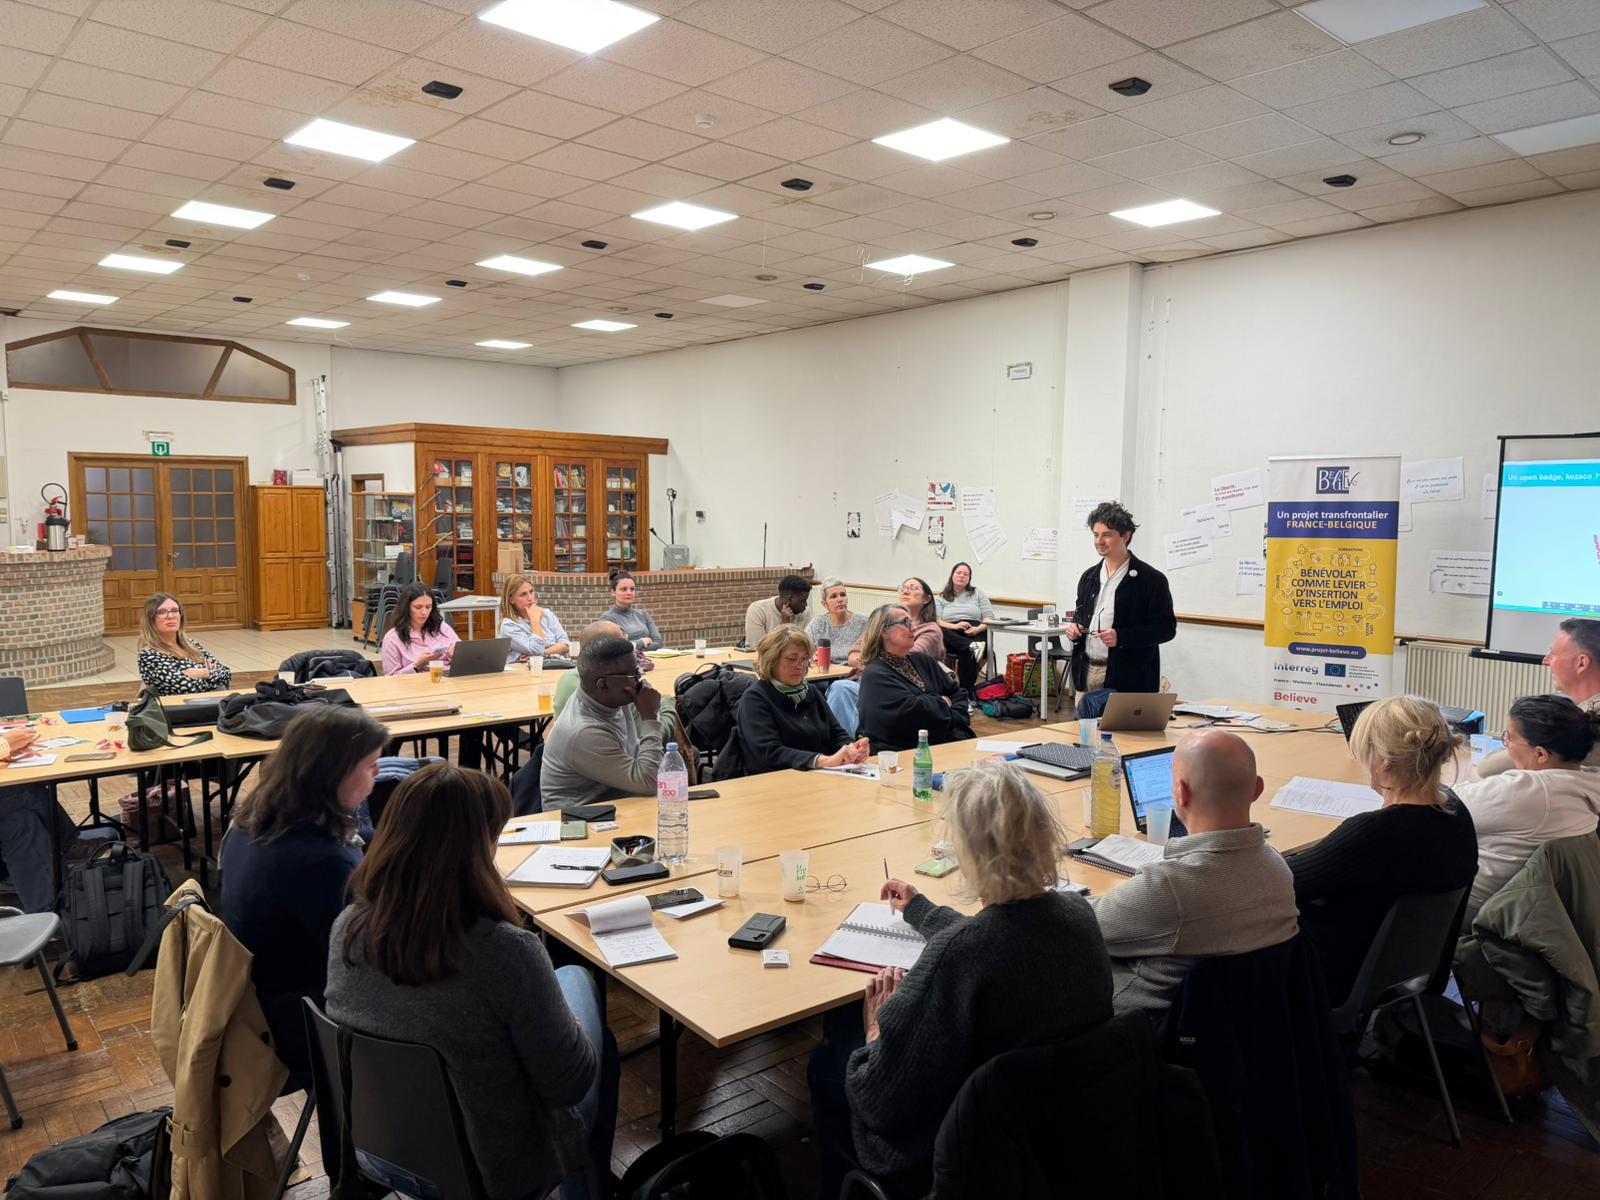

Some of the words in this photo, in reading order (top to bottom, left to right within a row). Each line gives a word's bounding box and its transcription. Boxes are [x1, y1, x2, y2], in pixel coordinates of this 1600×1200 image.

[1519, 474, 1537, 482] open
[1276, 511, 1290, 519] Un
[1291, 511, 1319, 521] projet
[1321, 510, 1389, 519] transfrontalier
[1286, 520, 1378, 530] FRANCE-BELGIQUE
[1300, 567, 1358, 579] BÉNÉVOLAT
[1291, 578, 1331, 589] COMME
[1332, 580, 1366, 590] LEVIER
[1295, 588, 1358, 600] D’INSERTION
[1292, 598, 1317, 608] VERS
[1318, 599, 1363, 611] L’EMPLOI
[1295, 646, 1360, 656] www.projet-believe.eu
[1274, 691, 1318, 705] Believe
